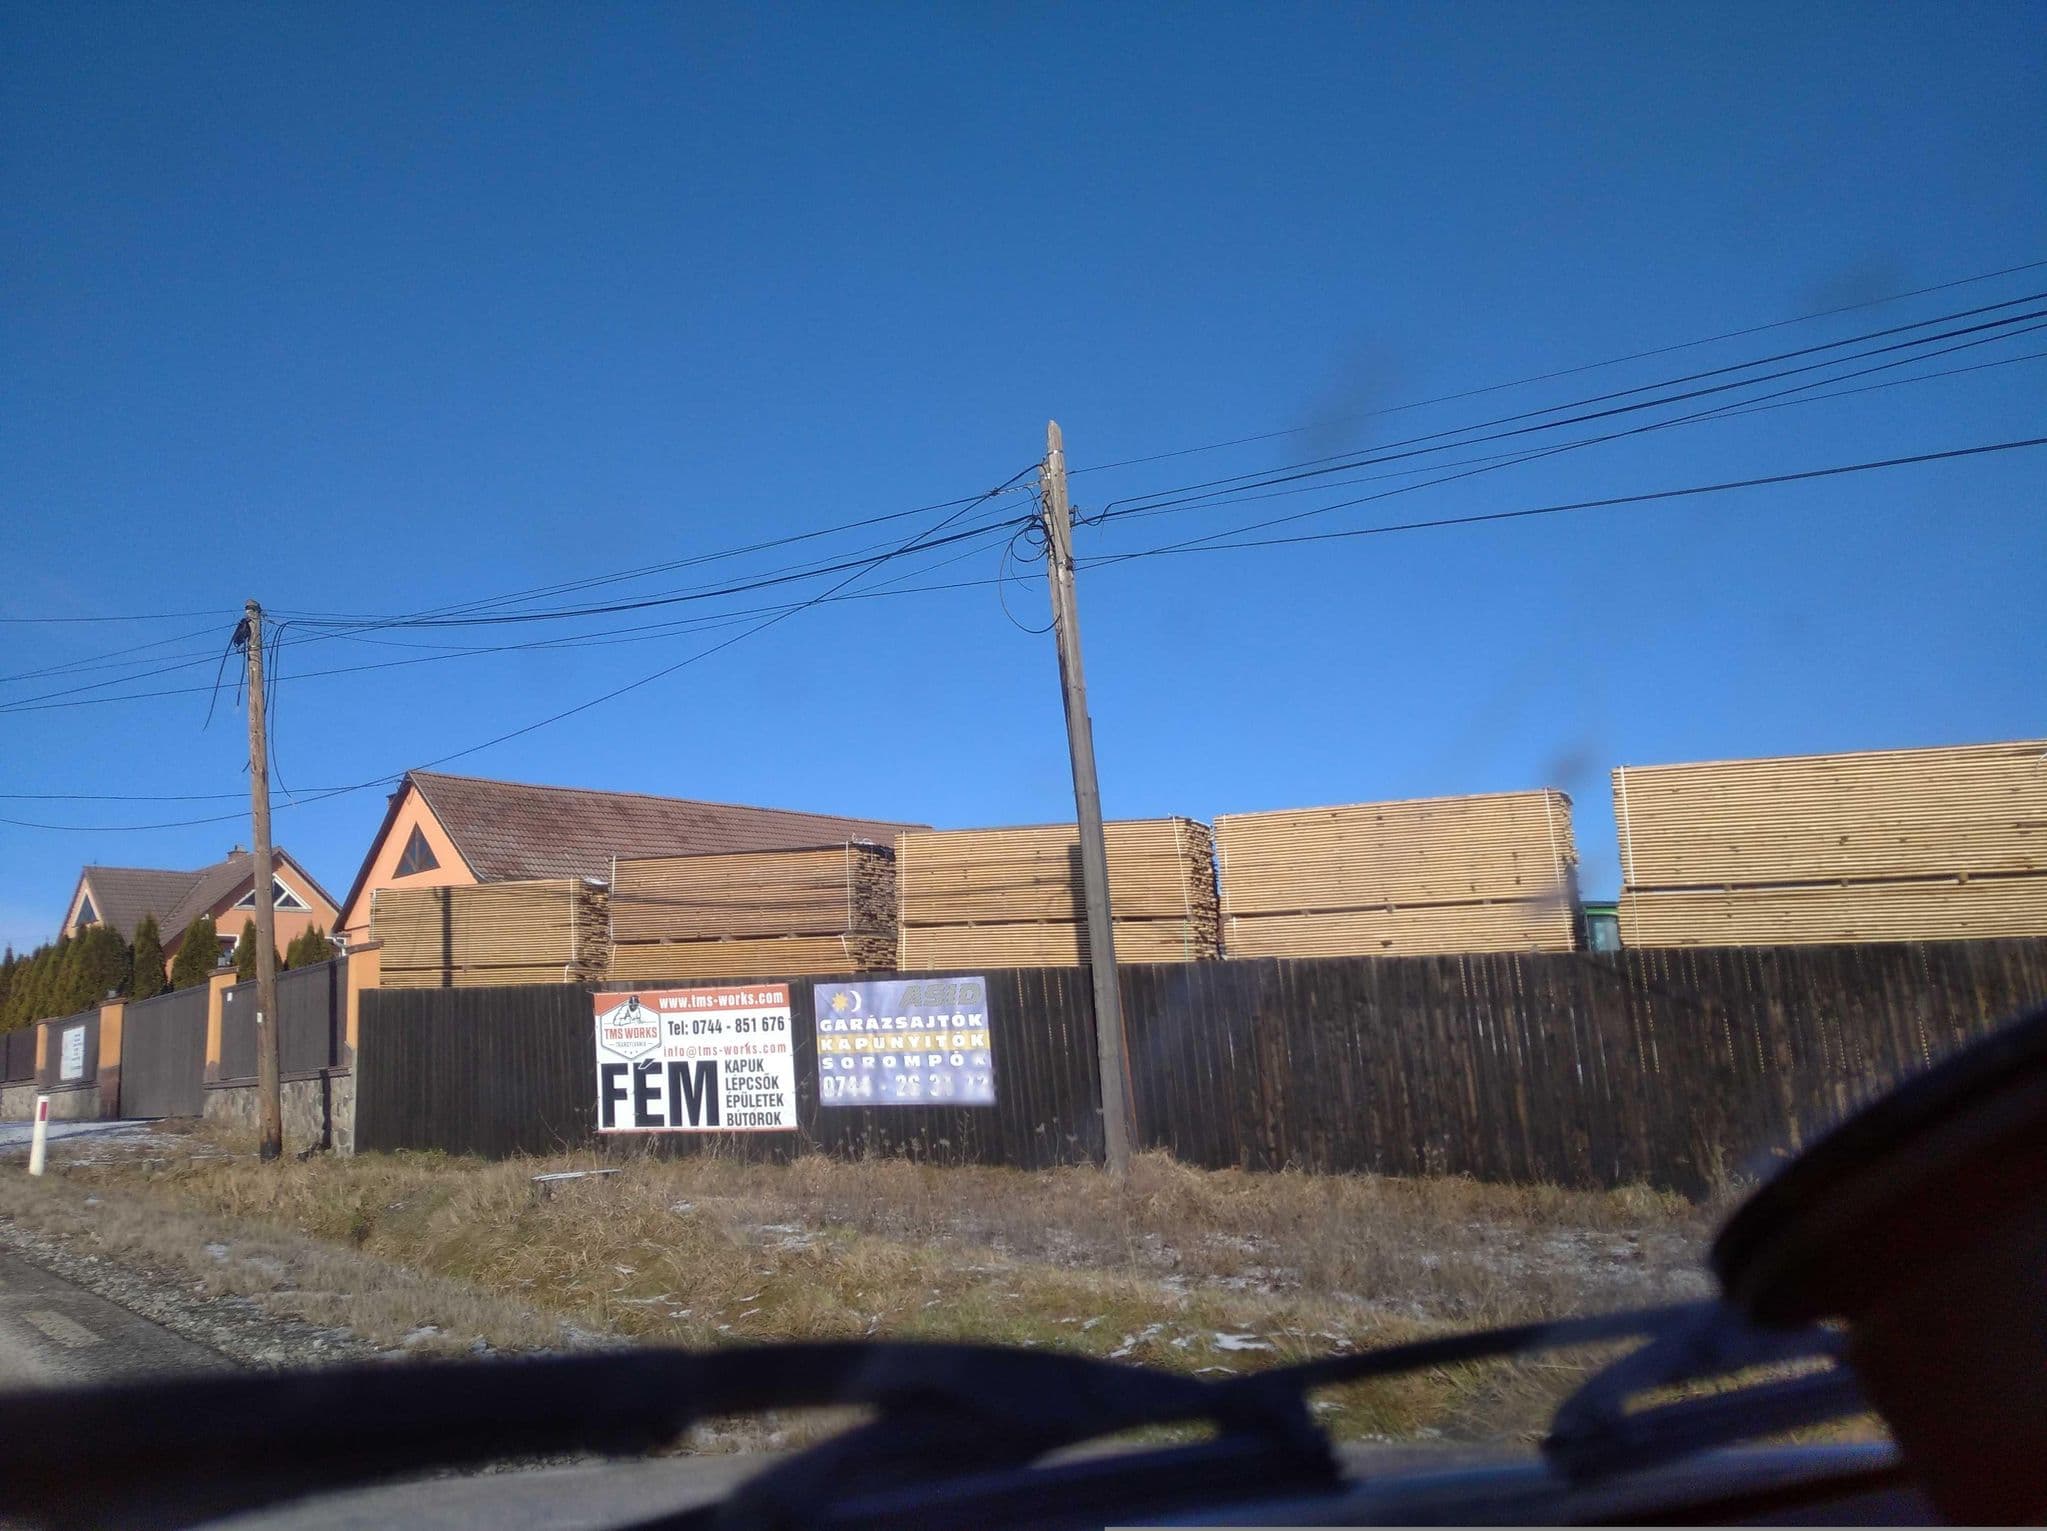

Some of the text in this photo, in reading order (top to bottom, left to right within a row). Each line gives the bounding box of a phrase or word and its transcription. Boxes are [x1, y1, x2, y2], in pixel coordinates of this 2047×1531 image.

[659, 991, 784, 1009] www.tms-works.com
[668, 1020, 689, 1036] Tel:
[692, 1019, 722, 1035] 0744
[735, 1018, 756, 1033] 851
[762, 1016, 785, 1031] 676
[820, 1013, 982, 1031] GARÁZSAJTÓK
[604, 1026, 657, 1040] TMS WORKS
[821, 1032, 984, 1050] KAPUNYITÓK
[664, 1043, 787, 1058] info@tms-works.com
[725, 1058, 764, 1073] KAPUK
[725, 1073, 779, 1091] LÉPCSŐK
[823, 1076, 871, 1097] 0744
[601, 1058, 720, 1127] FÉM
[726, 1091, 784, 1108] ÉPÜLETEK
